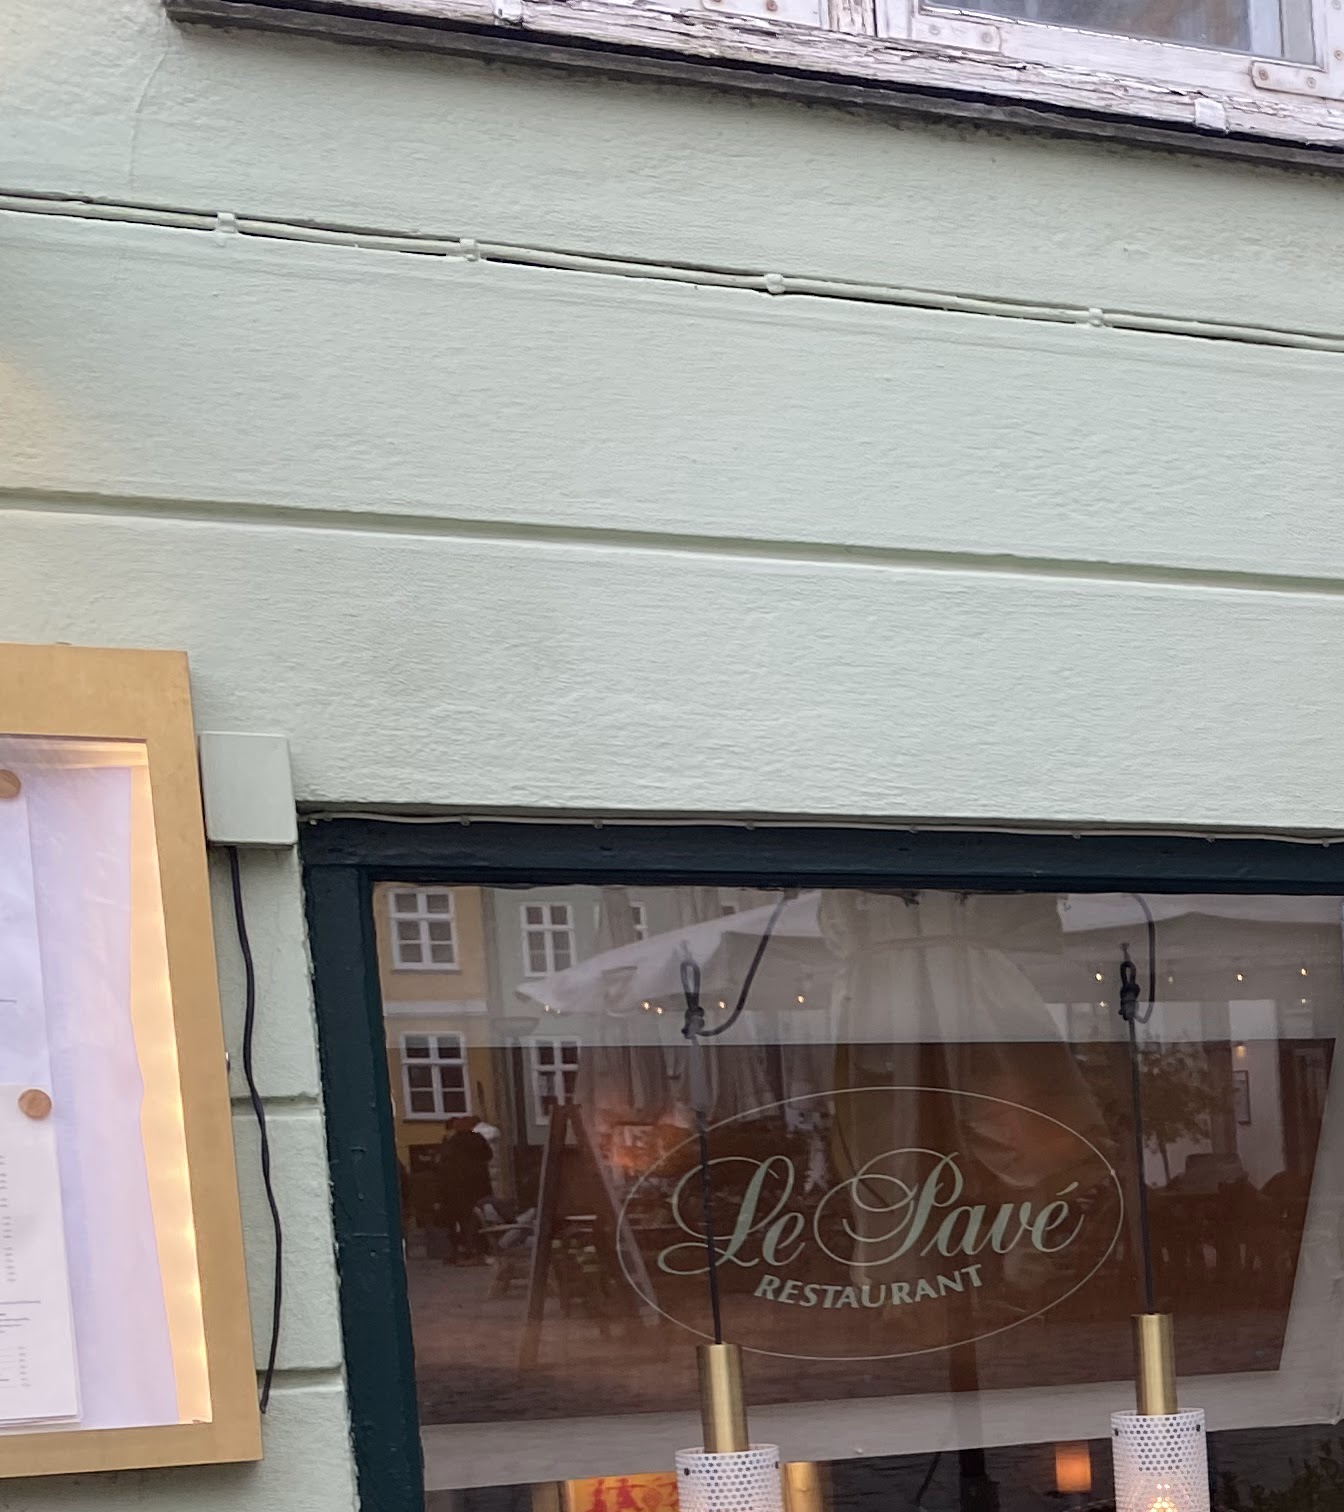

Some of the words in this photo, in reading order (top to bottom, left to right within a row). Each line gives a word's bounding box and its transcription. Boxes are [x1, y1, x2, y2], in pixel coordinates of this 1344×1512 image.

[657, 1155, 806, 1276] Le
[813, 1147, 1085, 1268] Pavé
[754, 1264, 985, 1310] RESTAURANT
